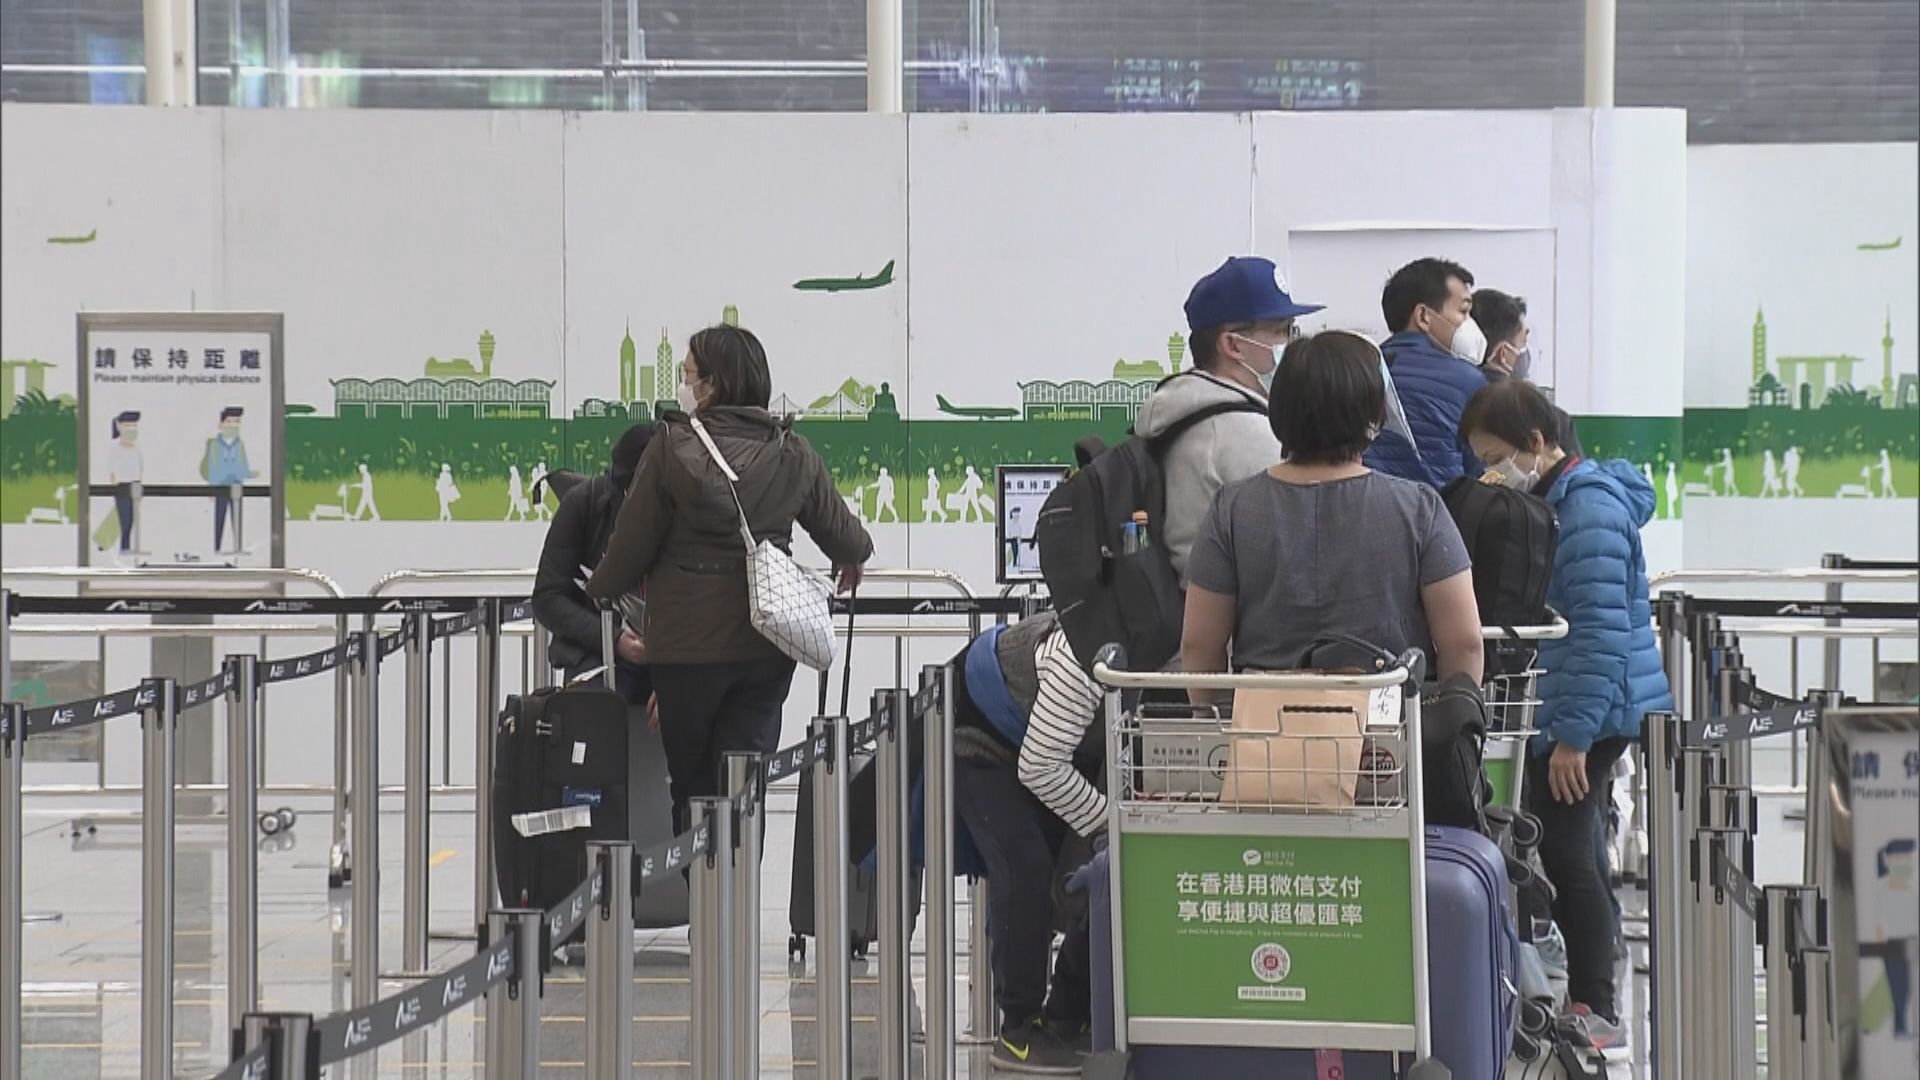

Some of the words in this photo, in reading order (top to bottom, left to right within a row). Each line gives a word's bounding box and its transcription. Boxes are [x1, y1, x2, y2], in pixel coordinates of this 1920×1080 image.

[95, 348, 261, 369] 請保持距離
[94, 373, 128, 383] Please
[131, 373, 173, 383] maintain
[176, 373, 216, 385] physical
[220, 373, 261, 383] distance
[1176, 872, 1362, 898] 在香港用微信支付
[1177, 900, 1363, 926] 享便捷與超優匯率
